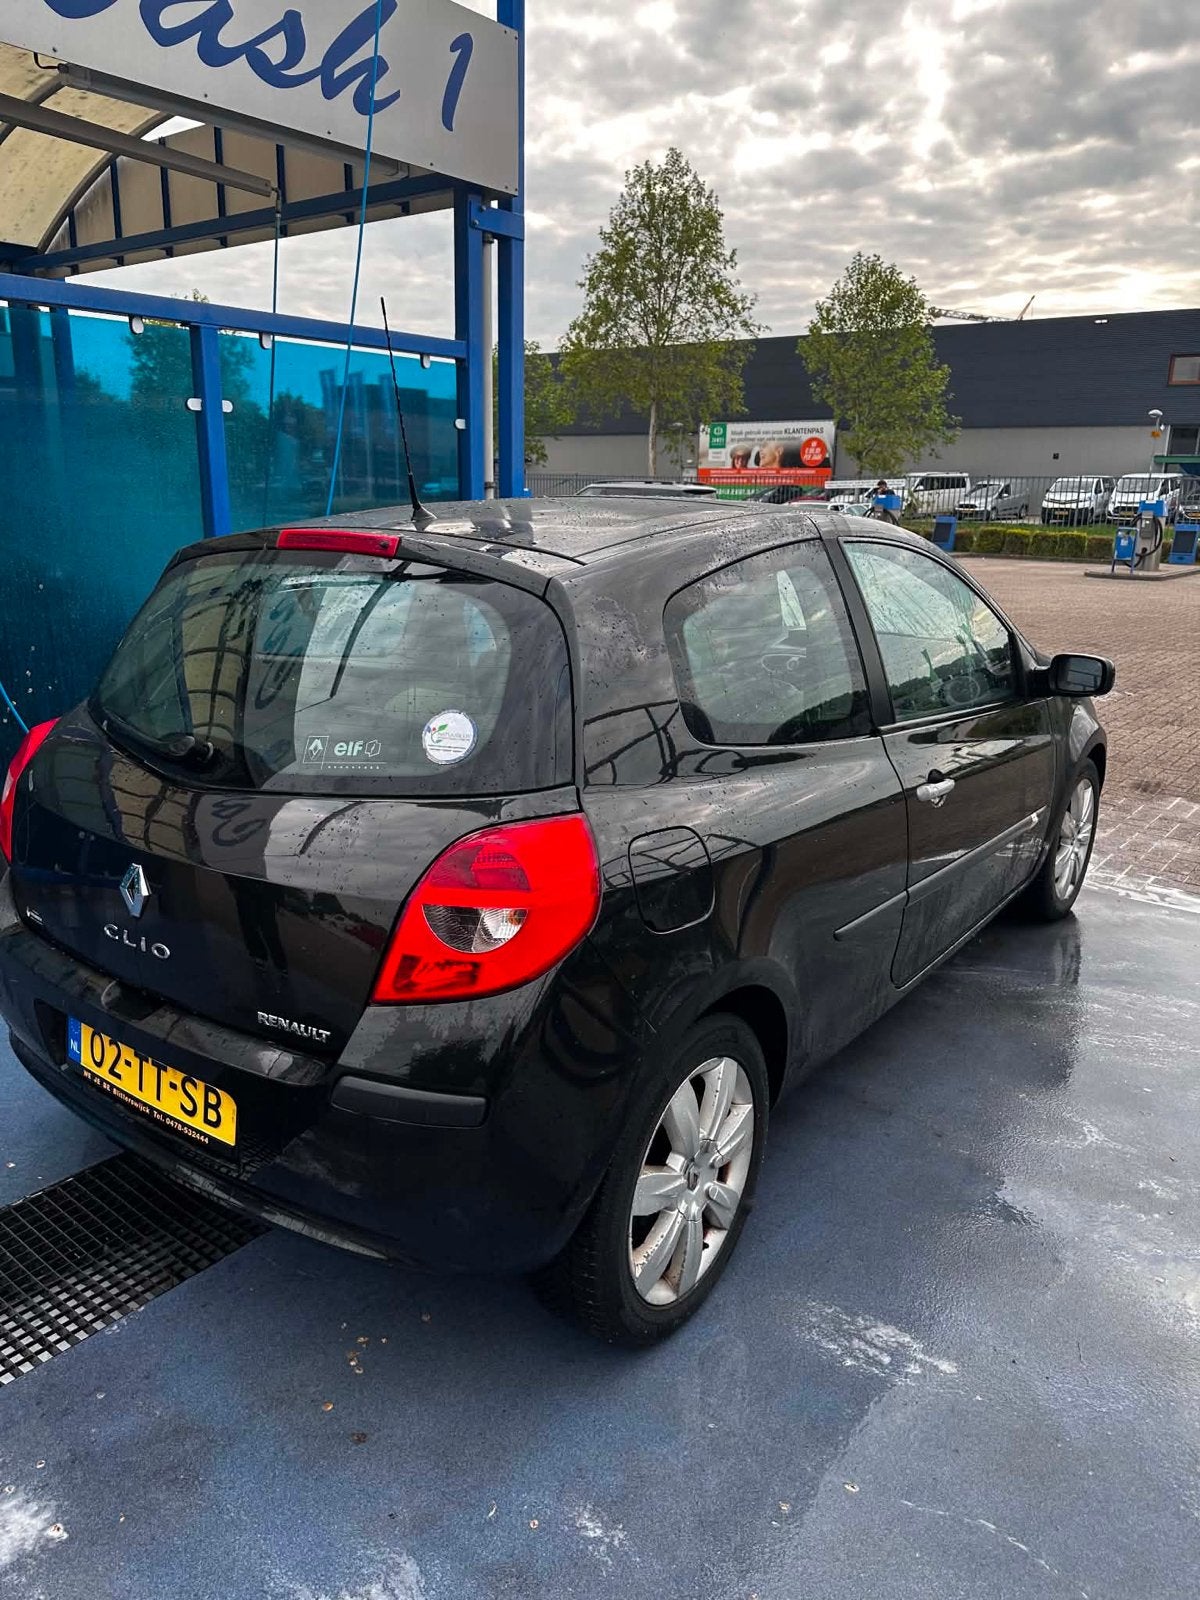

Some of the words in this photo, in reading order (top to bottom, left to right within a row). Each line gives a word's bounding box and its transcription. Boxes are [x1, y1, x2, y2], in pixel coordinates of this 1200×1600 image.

[43, 0, 400, 115] ash
[441, 33, 474, 132] 1
[784, 427, 824, 435] KLANTENPAS
[334, 740, 363, 756] elf
[103, 923, 171, 960] CLIO
[257, 1010, 331, 1044] RENAULT
[70, 1038, 81, 1054] NL
[90, 1030, 222, 1129] 02-TT-SB
[153, 1110, 165, 1122] Tel.
[165, 1117, 209, 1145] 0478-532444
